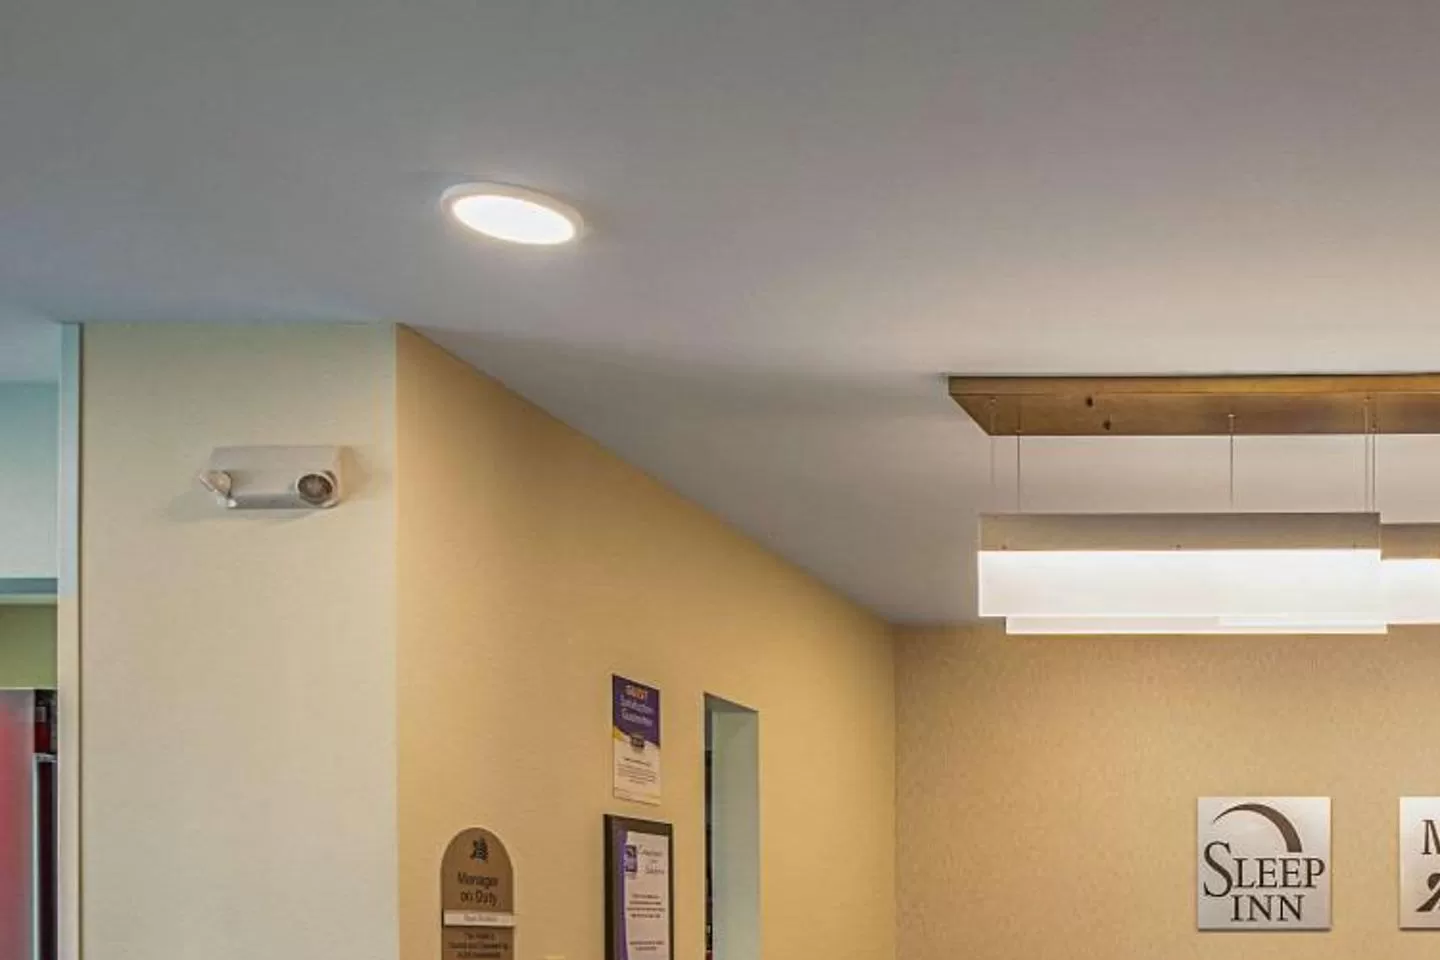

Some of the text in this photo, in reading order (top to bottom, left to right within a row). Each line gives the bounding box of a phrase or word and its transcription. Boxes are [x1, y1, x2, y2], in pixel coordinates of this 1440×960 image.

[457, 871, 499, 889] Manager
[1203, 841, 1326, 898] SLEEP
[460, 889, 498, 907] on Duty
[1230, 895, 1305, 921] INN
